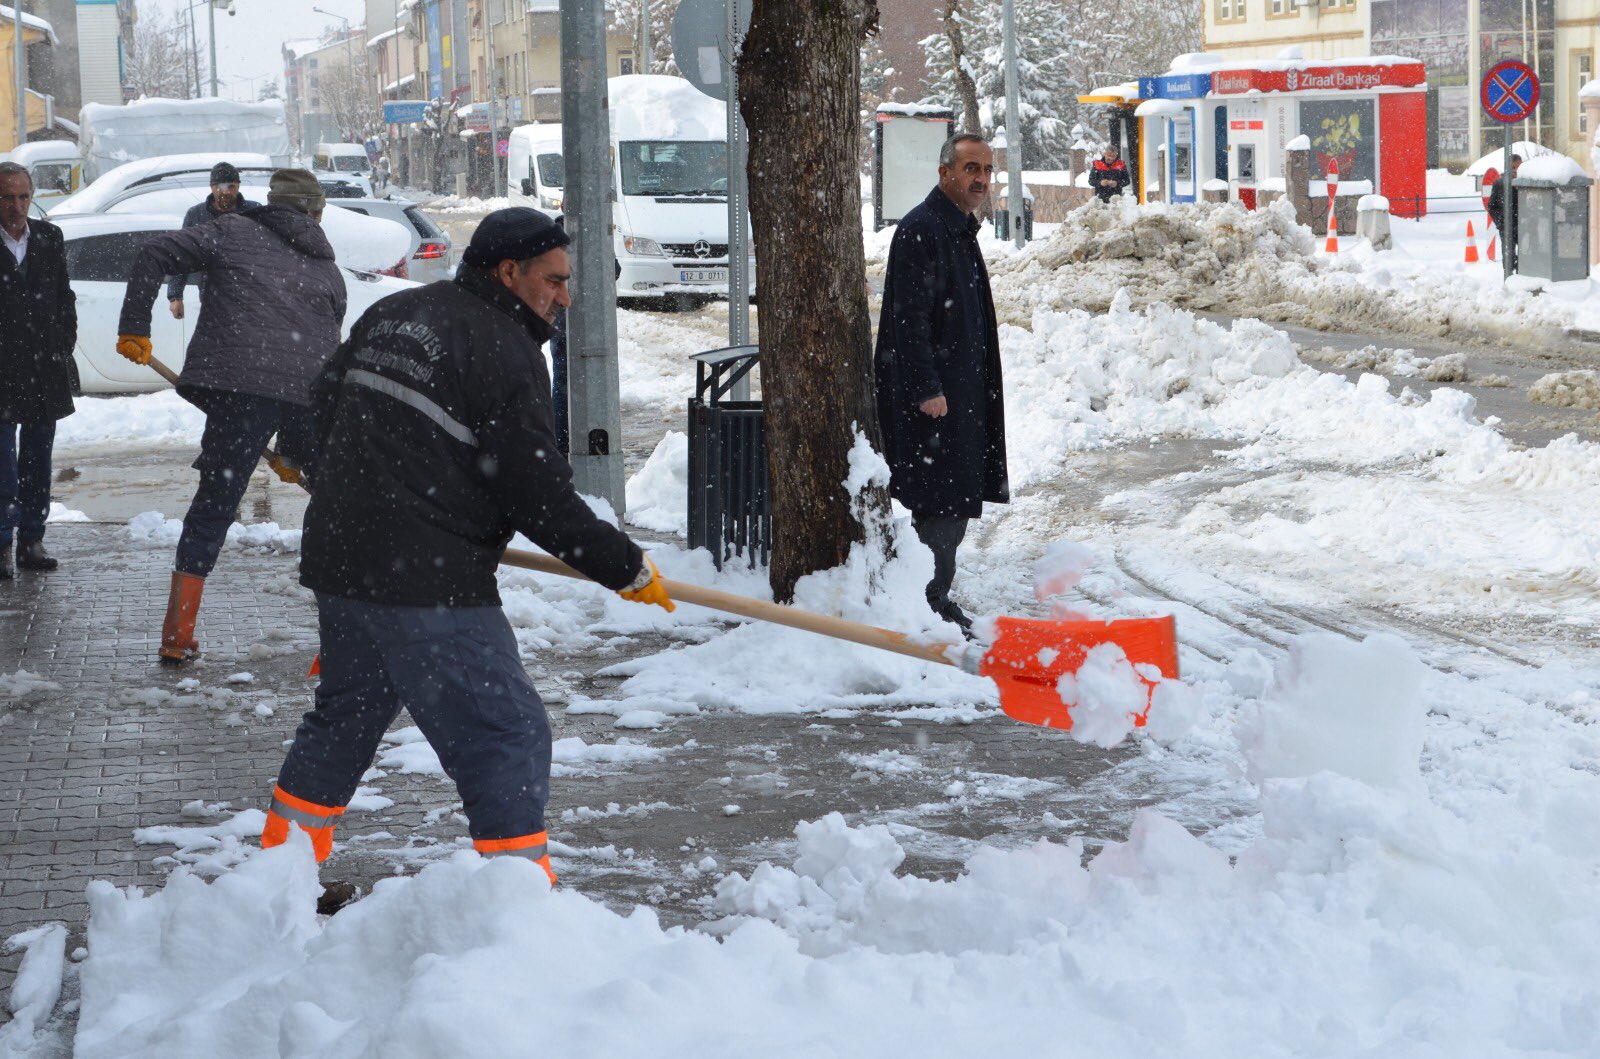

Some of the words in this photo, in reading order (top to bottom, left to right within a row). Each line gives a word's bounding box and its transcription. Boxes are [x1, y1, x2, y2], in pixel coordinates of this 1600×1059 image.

[1302, 73, 1335, 87] Ziraat
[1337, 71, 1381, 86] Bankası
[686, 272, 694, 280] 12
